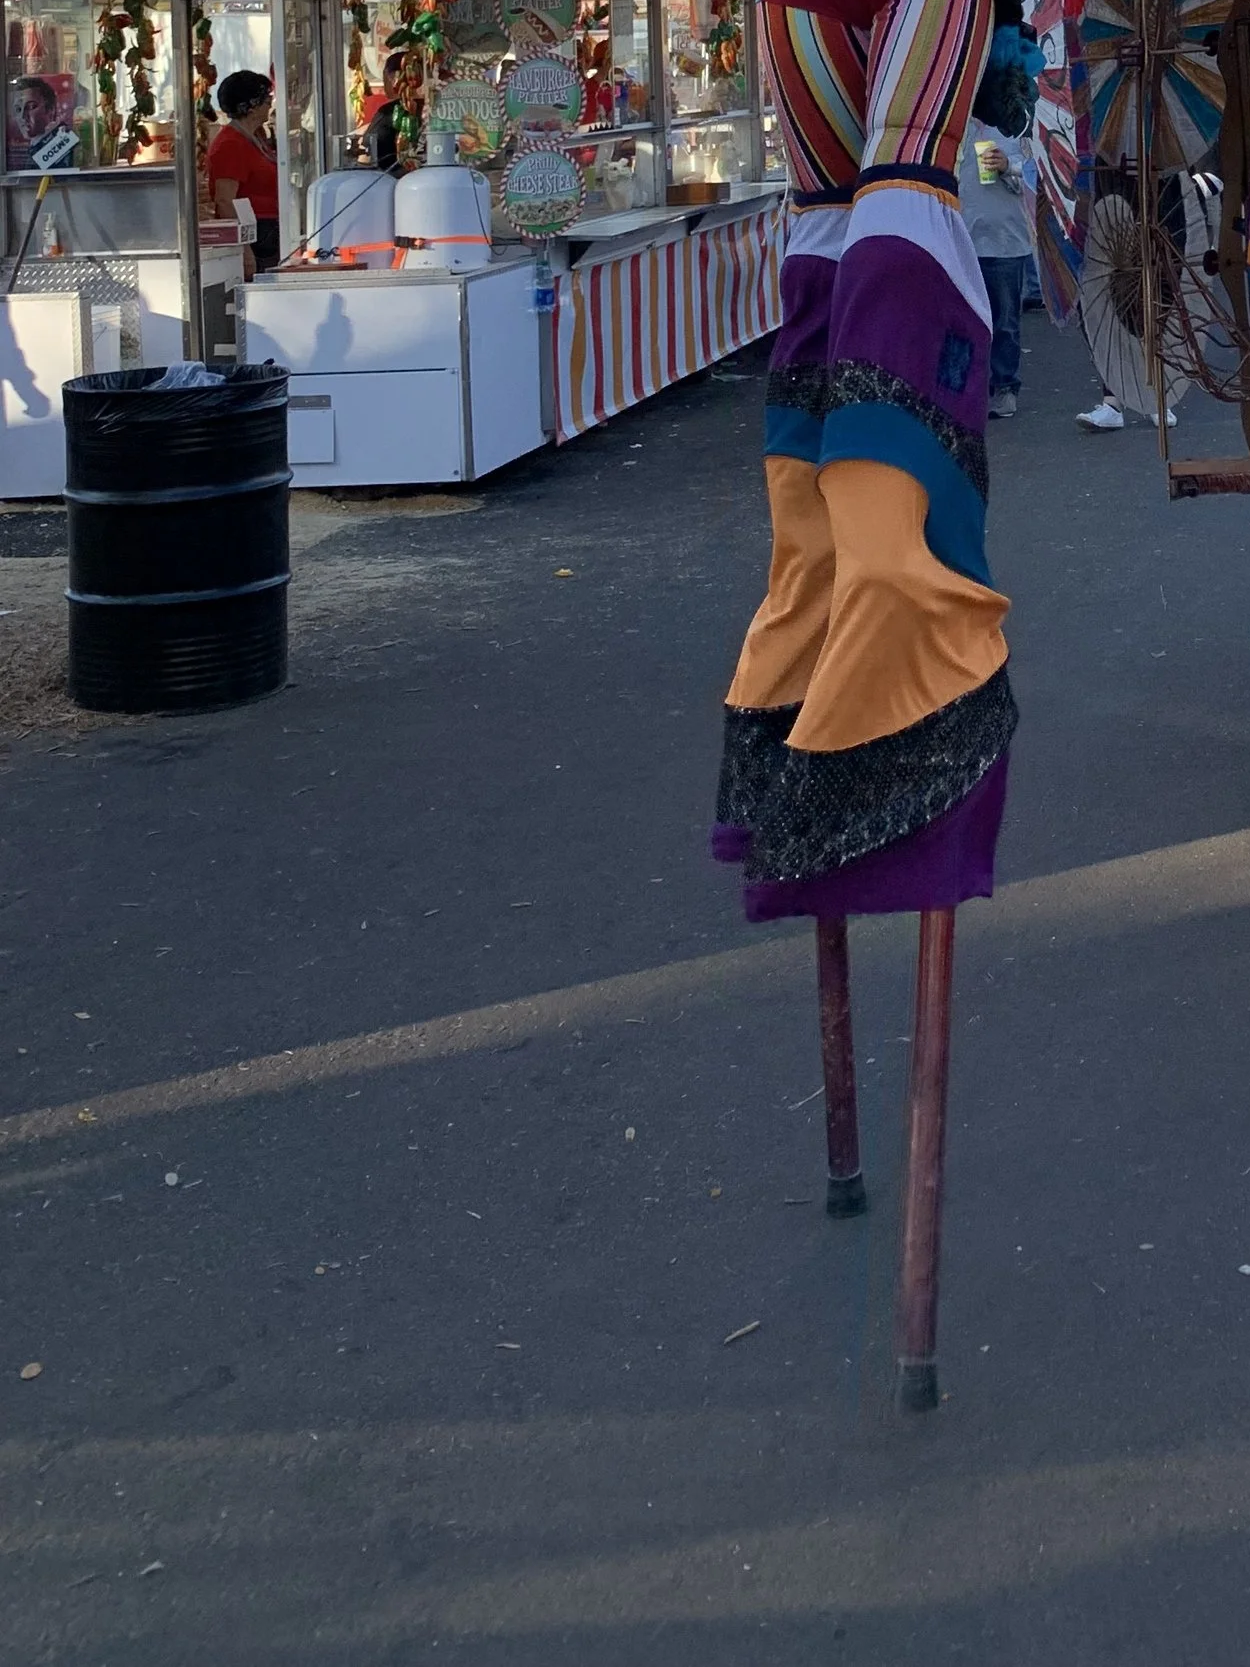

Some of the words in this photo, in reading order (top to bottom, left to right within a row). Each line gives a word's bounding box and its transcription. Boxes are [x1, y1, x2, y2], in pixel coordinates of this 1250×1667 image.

[508, 68, 577, 91] HAMBURGER
[516, 91, 569, 105] PLATTER
[507, 174, 543, 194] CHEESE
[545, 173, 578, 195] STEAK
